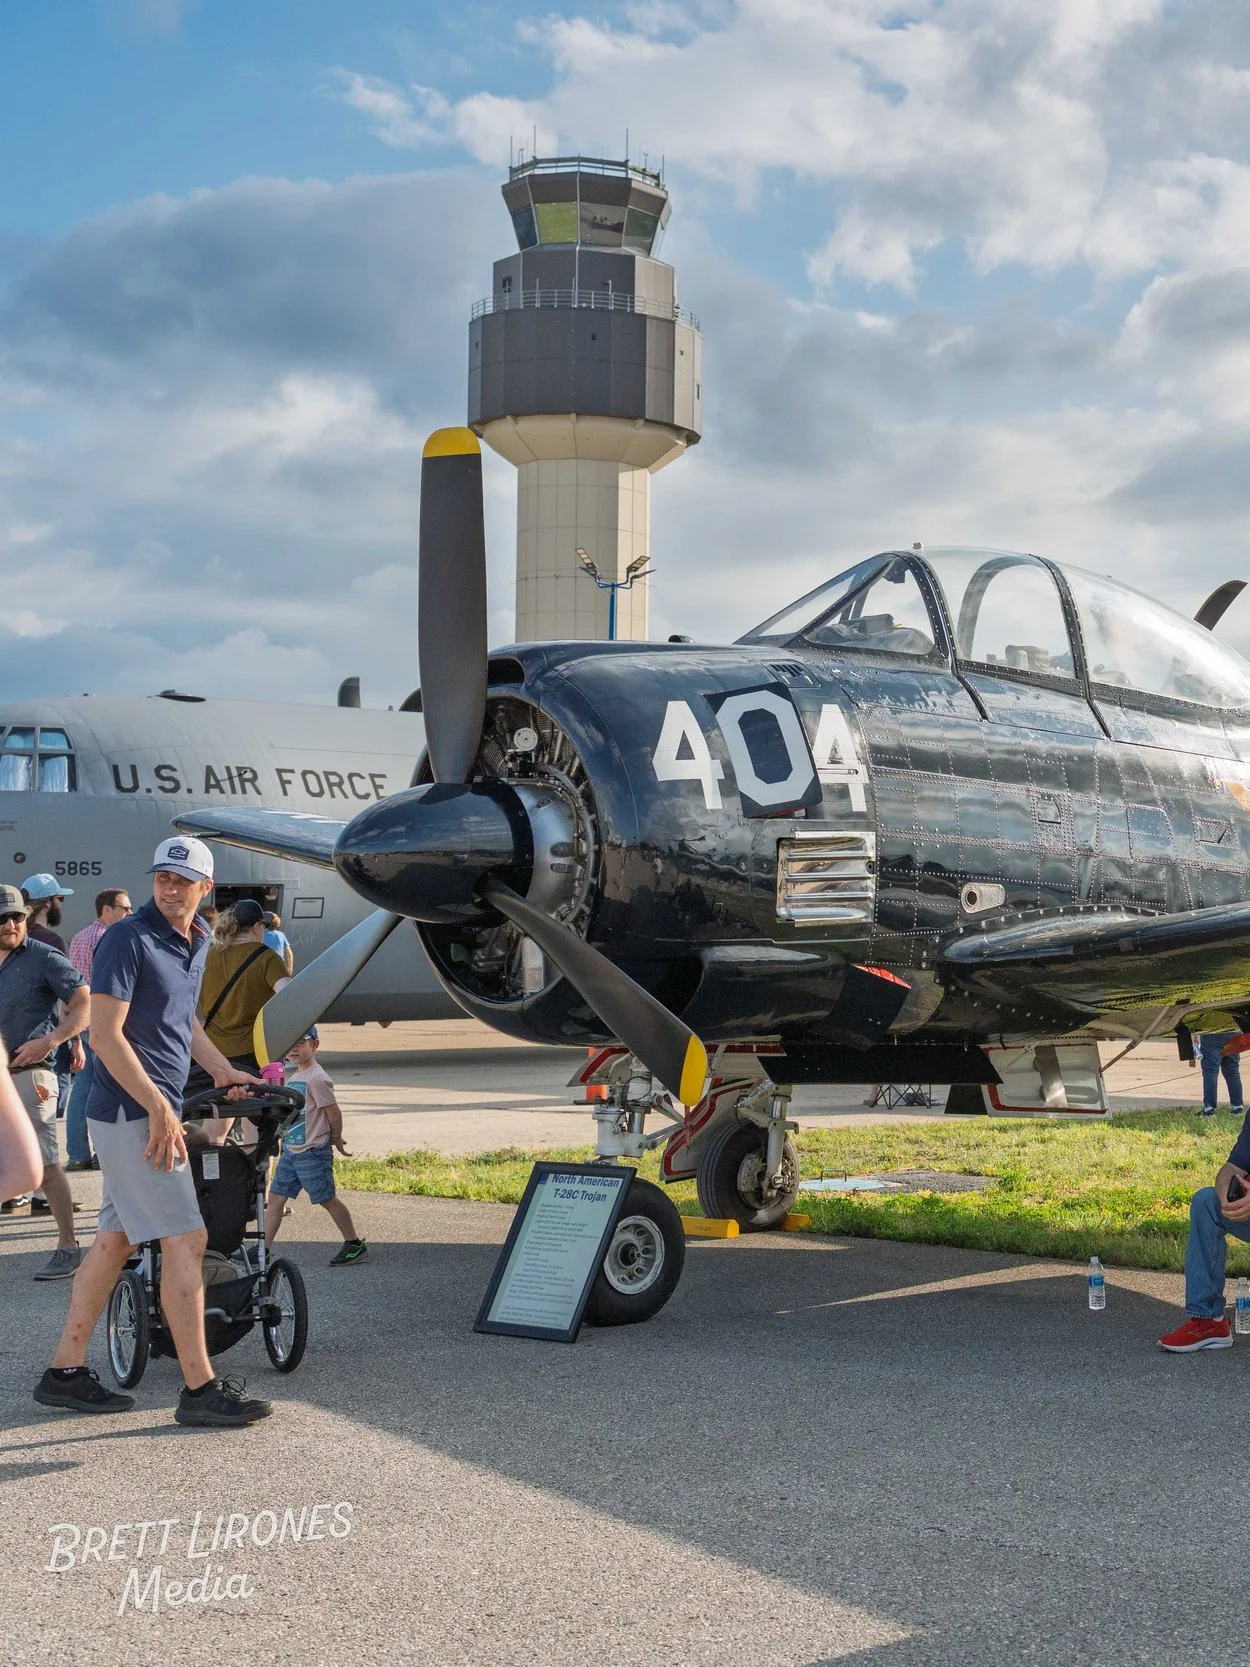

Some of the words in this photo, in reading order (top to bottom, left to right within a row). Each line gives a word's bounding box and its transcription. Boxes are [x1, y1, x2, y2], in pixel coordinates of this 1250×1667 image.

[651, 689, 870, 812] 404
[112, 764, 193, 795] U.S.
[204, 765, 262, 796] AIR
[275, 767, 388, 801] FORCE
[55, 861, 103, 877] 5865
[552, 1174, 577, 1185] North
[577, 1175, 620, 1188] American
[554, 1188, 579, 1200] T-28C
[580, 1190, 607, 1203] Trojan
